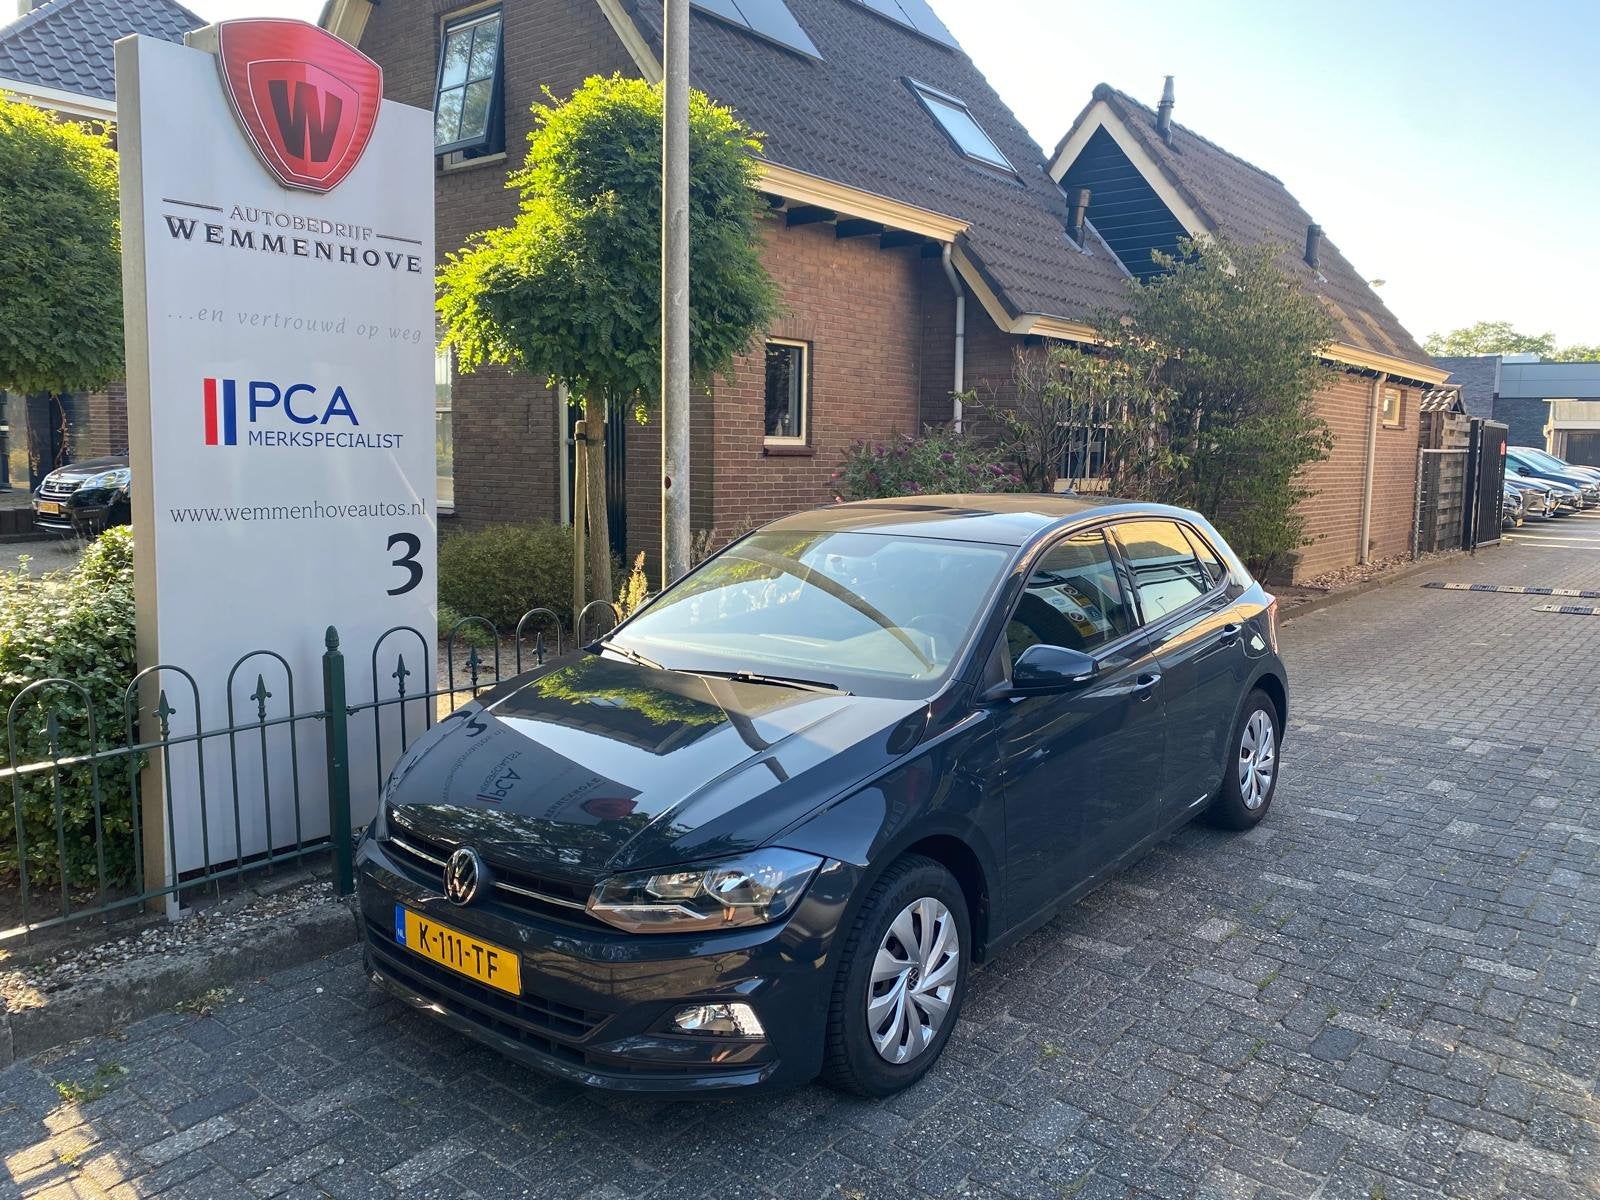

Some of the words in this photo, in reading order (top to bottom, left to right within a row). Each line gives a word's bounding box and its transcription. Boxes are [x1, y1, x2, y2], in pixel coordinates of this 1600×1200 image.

[230, 204, 373, 241] AUTOBEDRIJF
[163, 214, 422, 274] WEMMENHOVE
[238, 312, 347, 335] vertrouwd
[357, 323, 379, 340] op
[389, 328, 422, 344] weg
[248, 381, 360, 426] PCA
[248, 430, 404, 449] MERKSPECIALIST
[170, 498, 426, 523] www.wemmenhoveautos.nl
[386, 532, 424, 596] 3
[419, 921, 498, 979] K-111-TF
